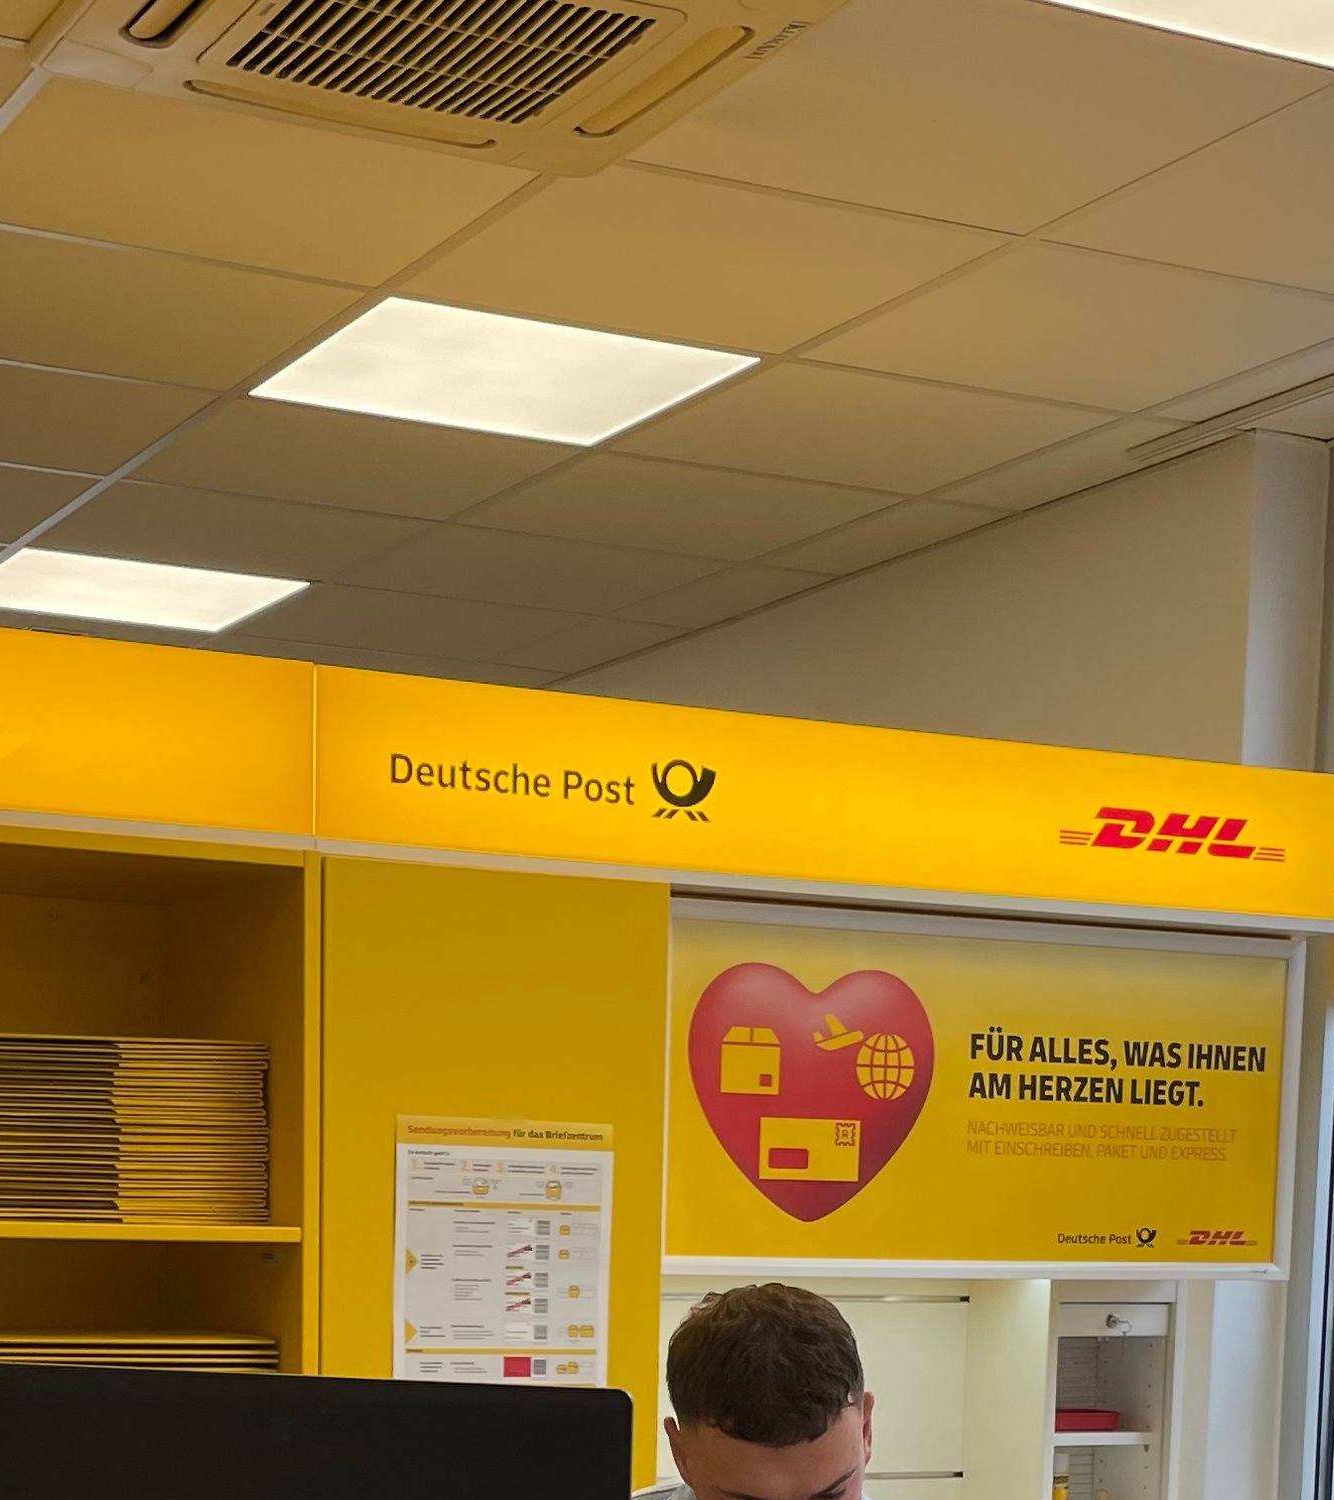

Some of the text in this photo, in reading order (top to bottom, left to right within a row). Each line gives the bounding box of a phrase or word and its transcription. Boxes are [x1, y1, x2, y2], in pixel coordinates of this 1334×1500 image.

[390, 752, 635, 806] Deutsche Post
[1091, 806, 1257, 860] DHL
[970, 1026, 1267, 1073] FÜR ALLES, WAS IHNEN
[968, 1072, 1204, 1107] AM HERZEN LIEGT.
[528, 1130, 544, 1139] das
[967, 1120, 1238, 1144] NACHWEISBAR UND SCHNELL ZUGESTELLT
[966, 1141, 990, 1154] MIT
[1096, 1145, 1138, 1160] PAKET
[1141, 1146, 1168, 1161] UND
[1057, 1233, 1132, 1245] Deutsche Post
[1189, 1231, 1245, 1246] DHL
